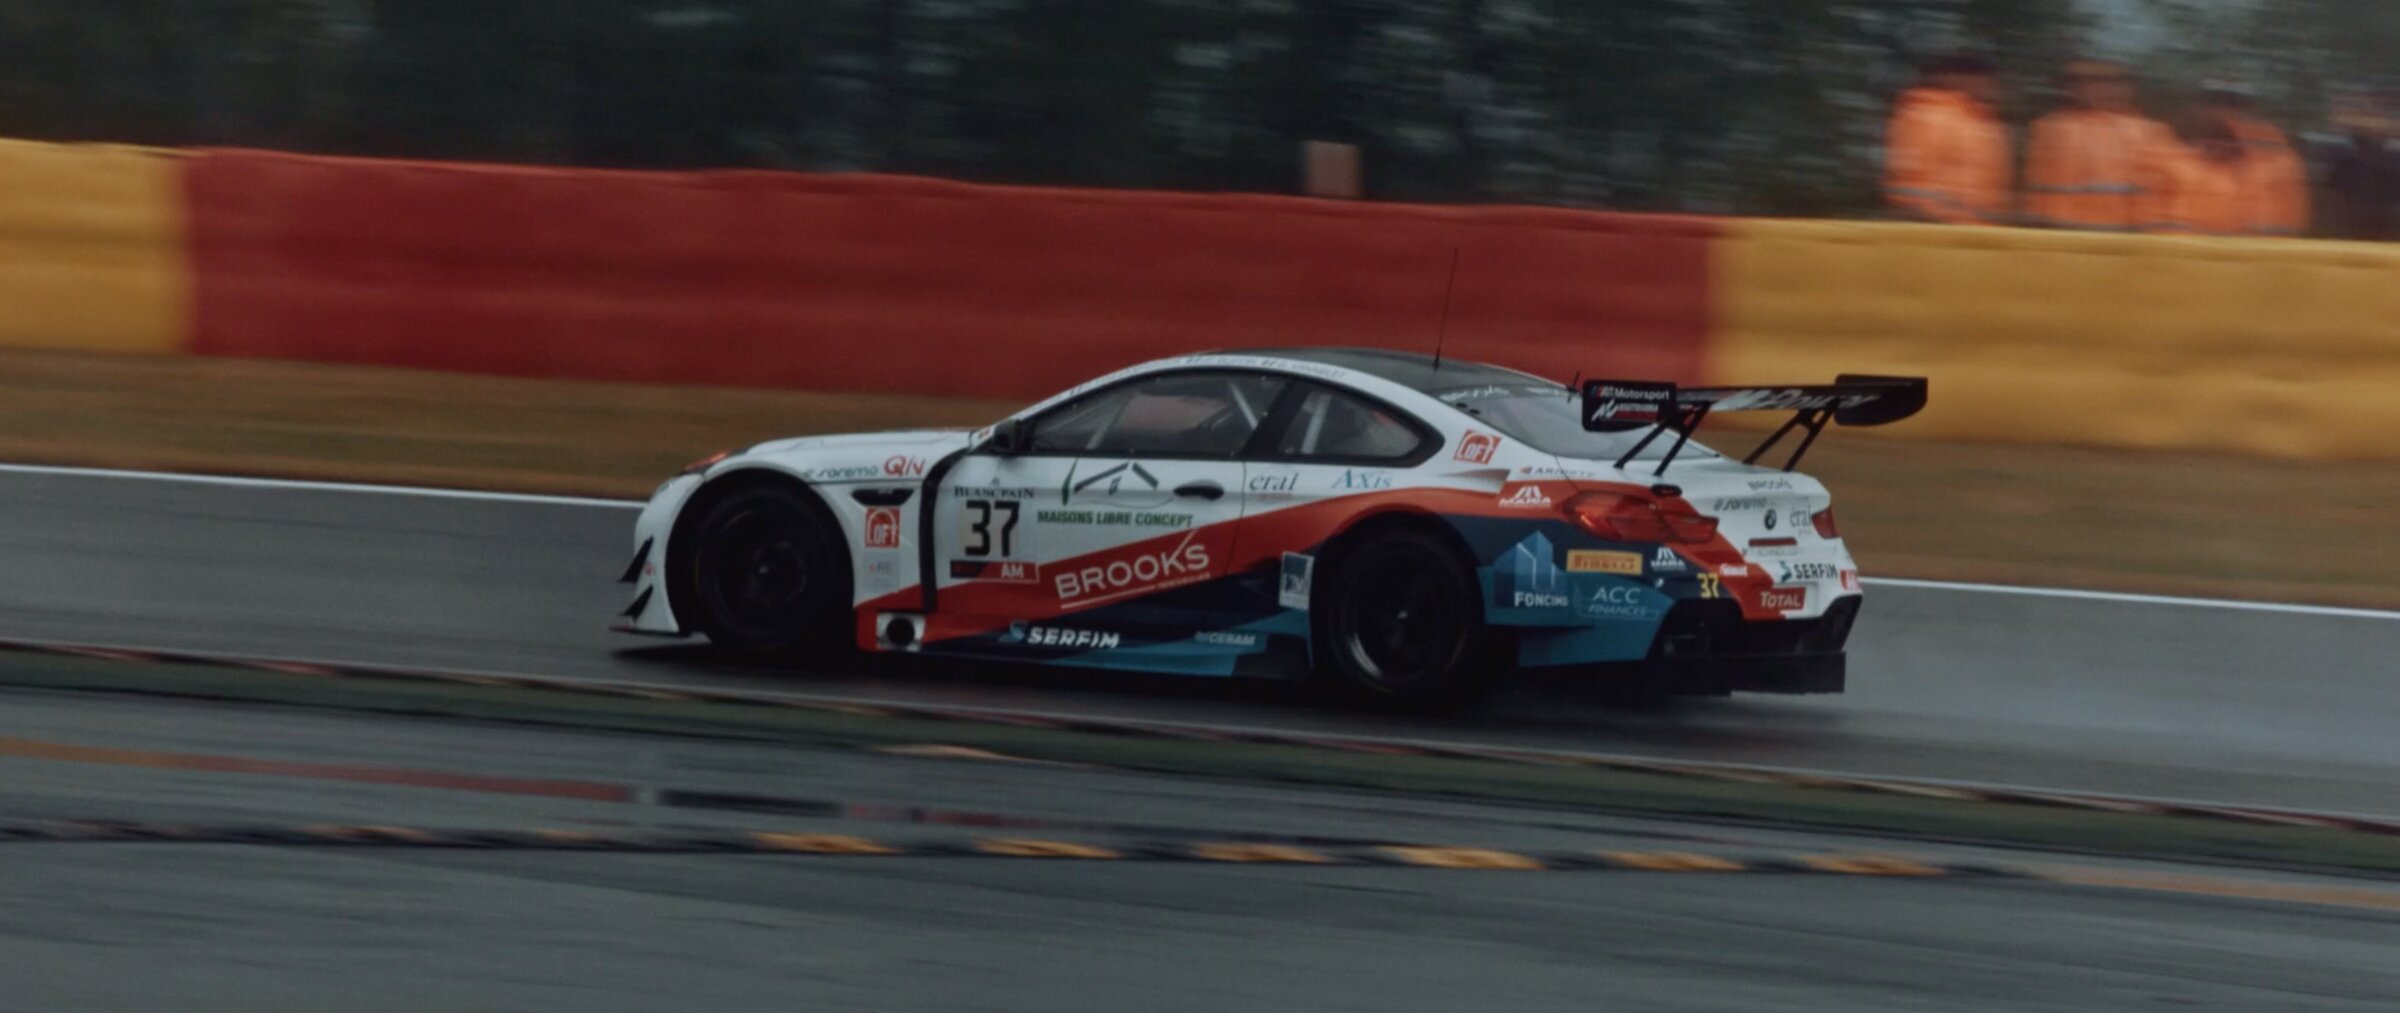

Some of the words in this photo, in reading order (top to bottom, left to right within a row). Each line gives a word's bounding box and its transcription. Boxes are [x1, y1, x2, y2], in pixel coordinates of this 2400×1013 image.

[1615, 387, 1670, 402] Motorsport
[1037, 510, 1093, 524] MAISONS
[1097, 511, 1132, 525] LIBRE
[1135, 512, 1194, 527] CONCEPT
[964, 499, 1020, 558] 37
[1001, 563, 1025, 578] AM
[1054, 530, 1210, 600] BROOKS
[1793, 563, 1838, 579] SERFIM
[1696, 572, 1720, 599] 37
[1591, 586, 1642, 604] ACC
[1759, 590, 1802, 608] TOTAL
[1027, 626, 1121, 649] SERFIM
